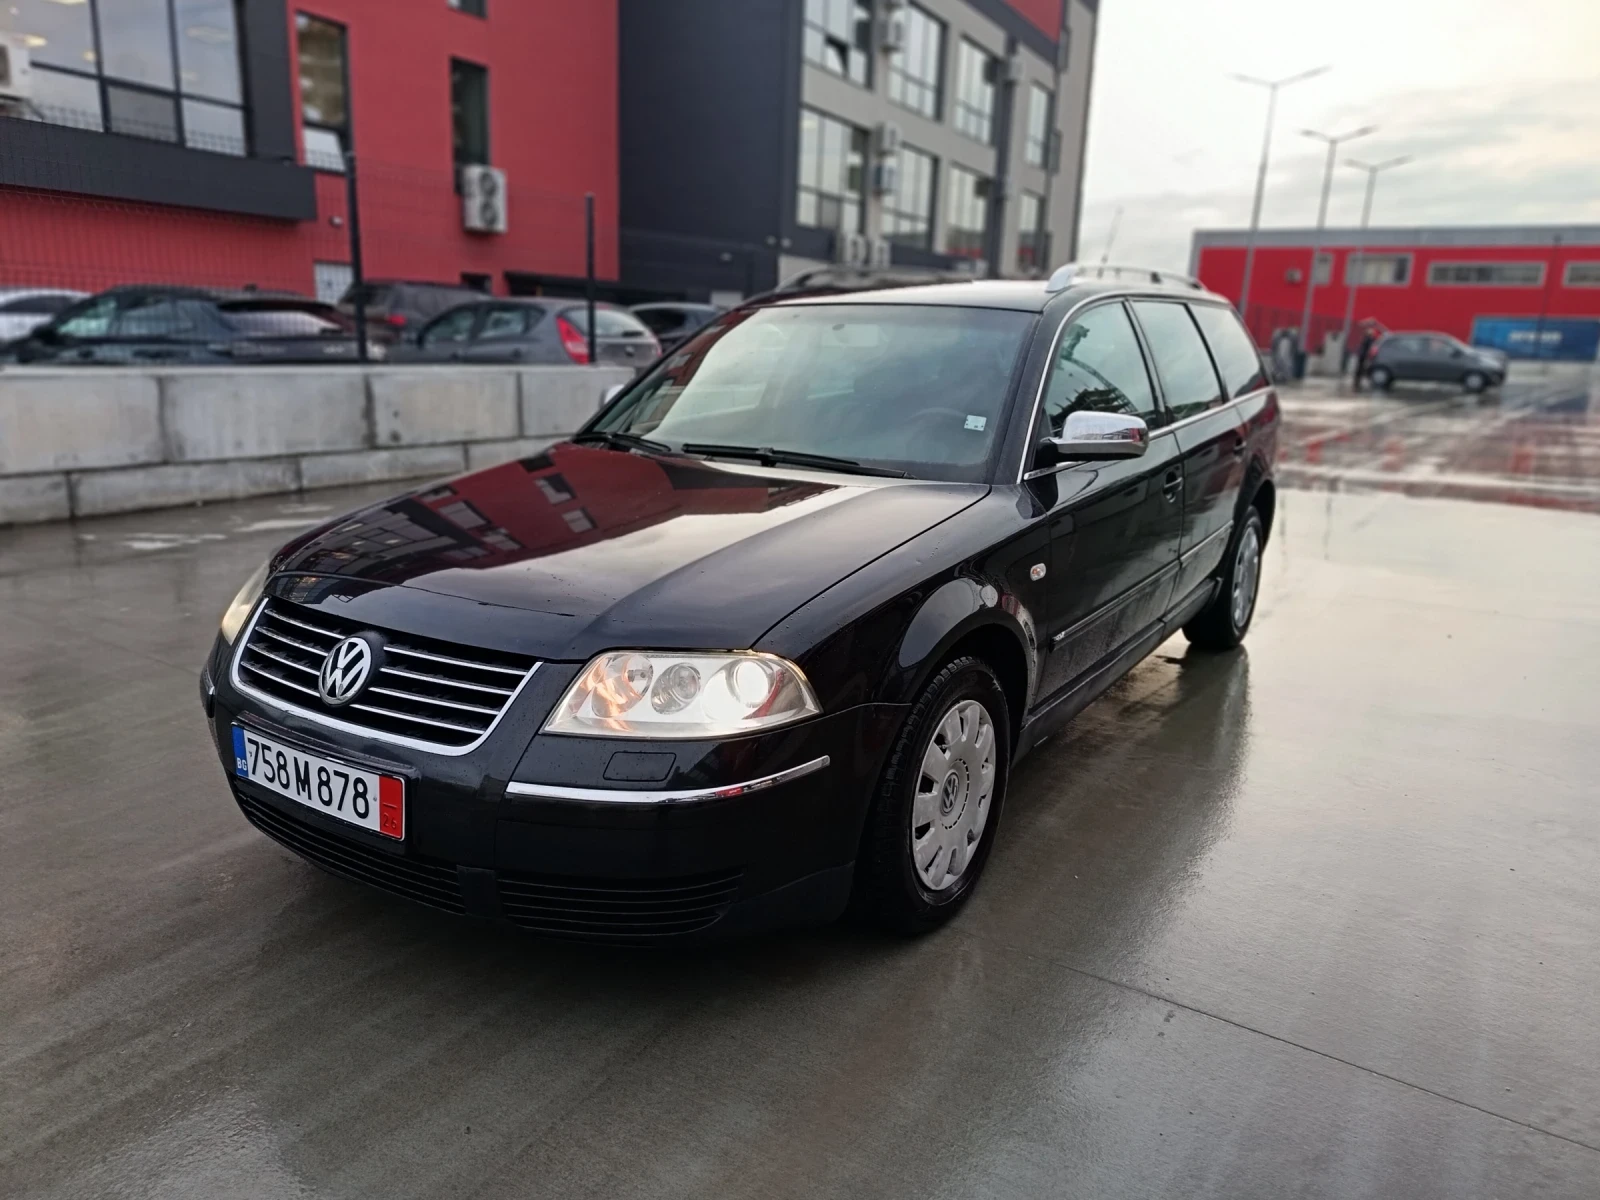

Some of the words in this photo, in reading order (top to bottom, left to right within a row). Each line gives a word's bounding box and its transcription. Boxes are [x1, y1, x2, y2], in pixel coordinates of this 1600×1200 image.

[319, 637, 371, 704] VW
[237, 757, 247, 771] BG
[383, 812, 397, 829] 26
